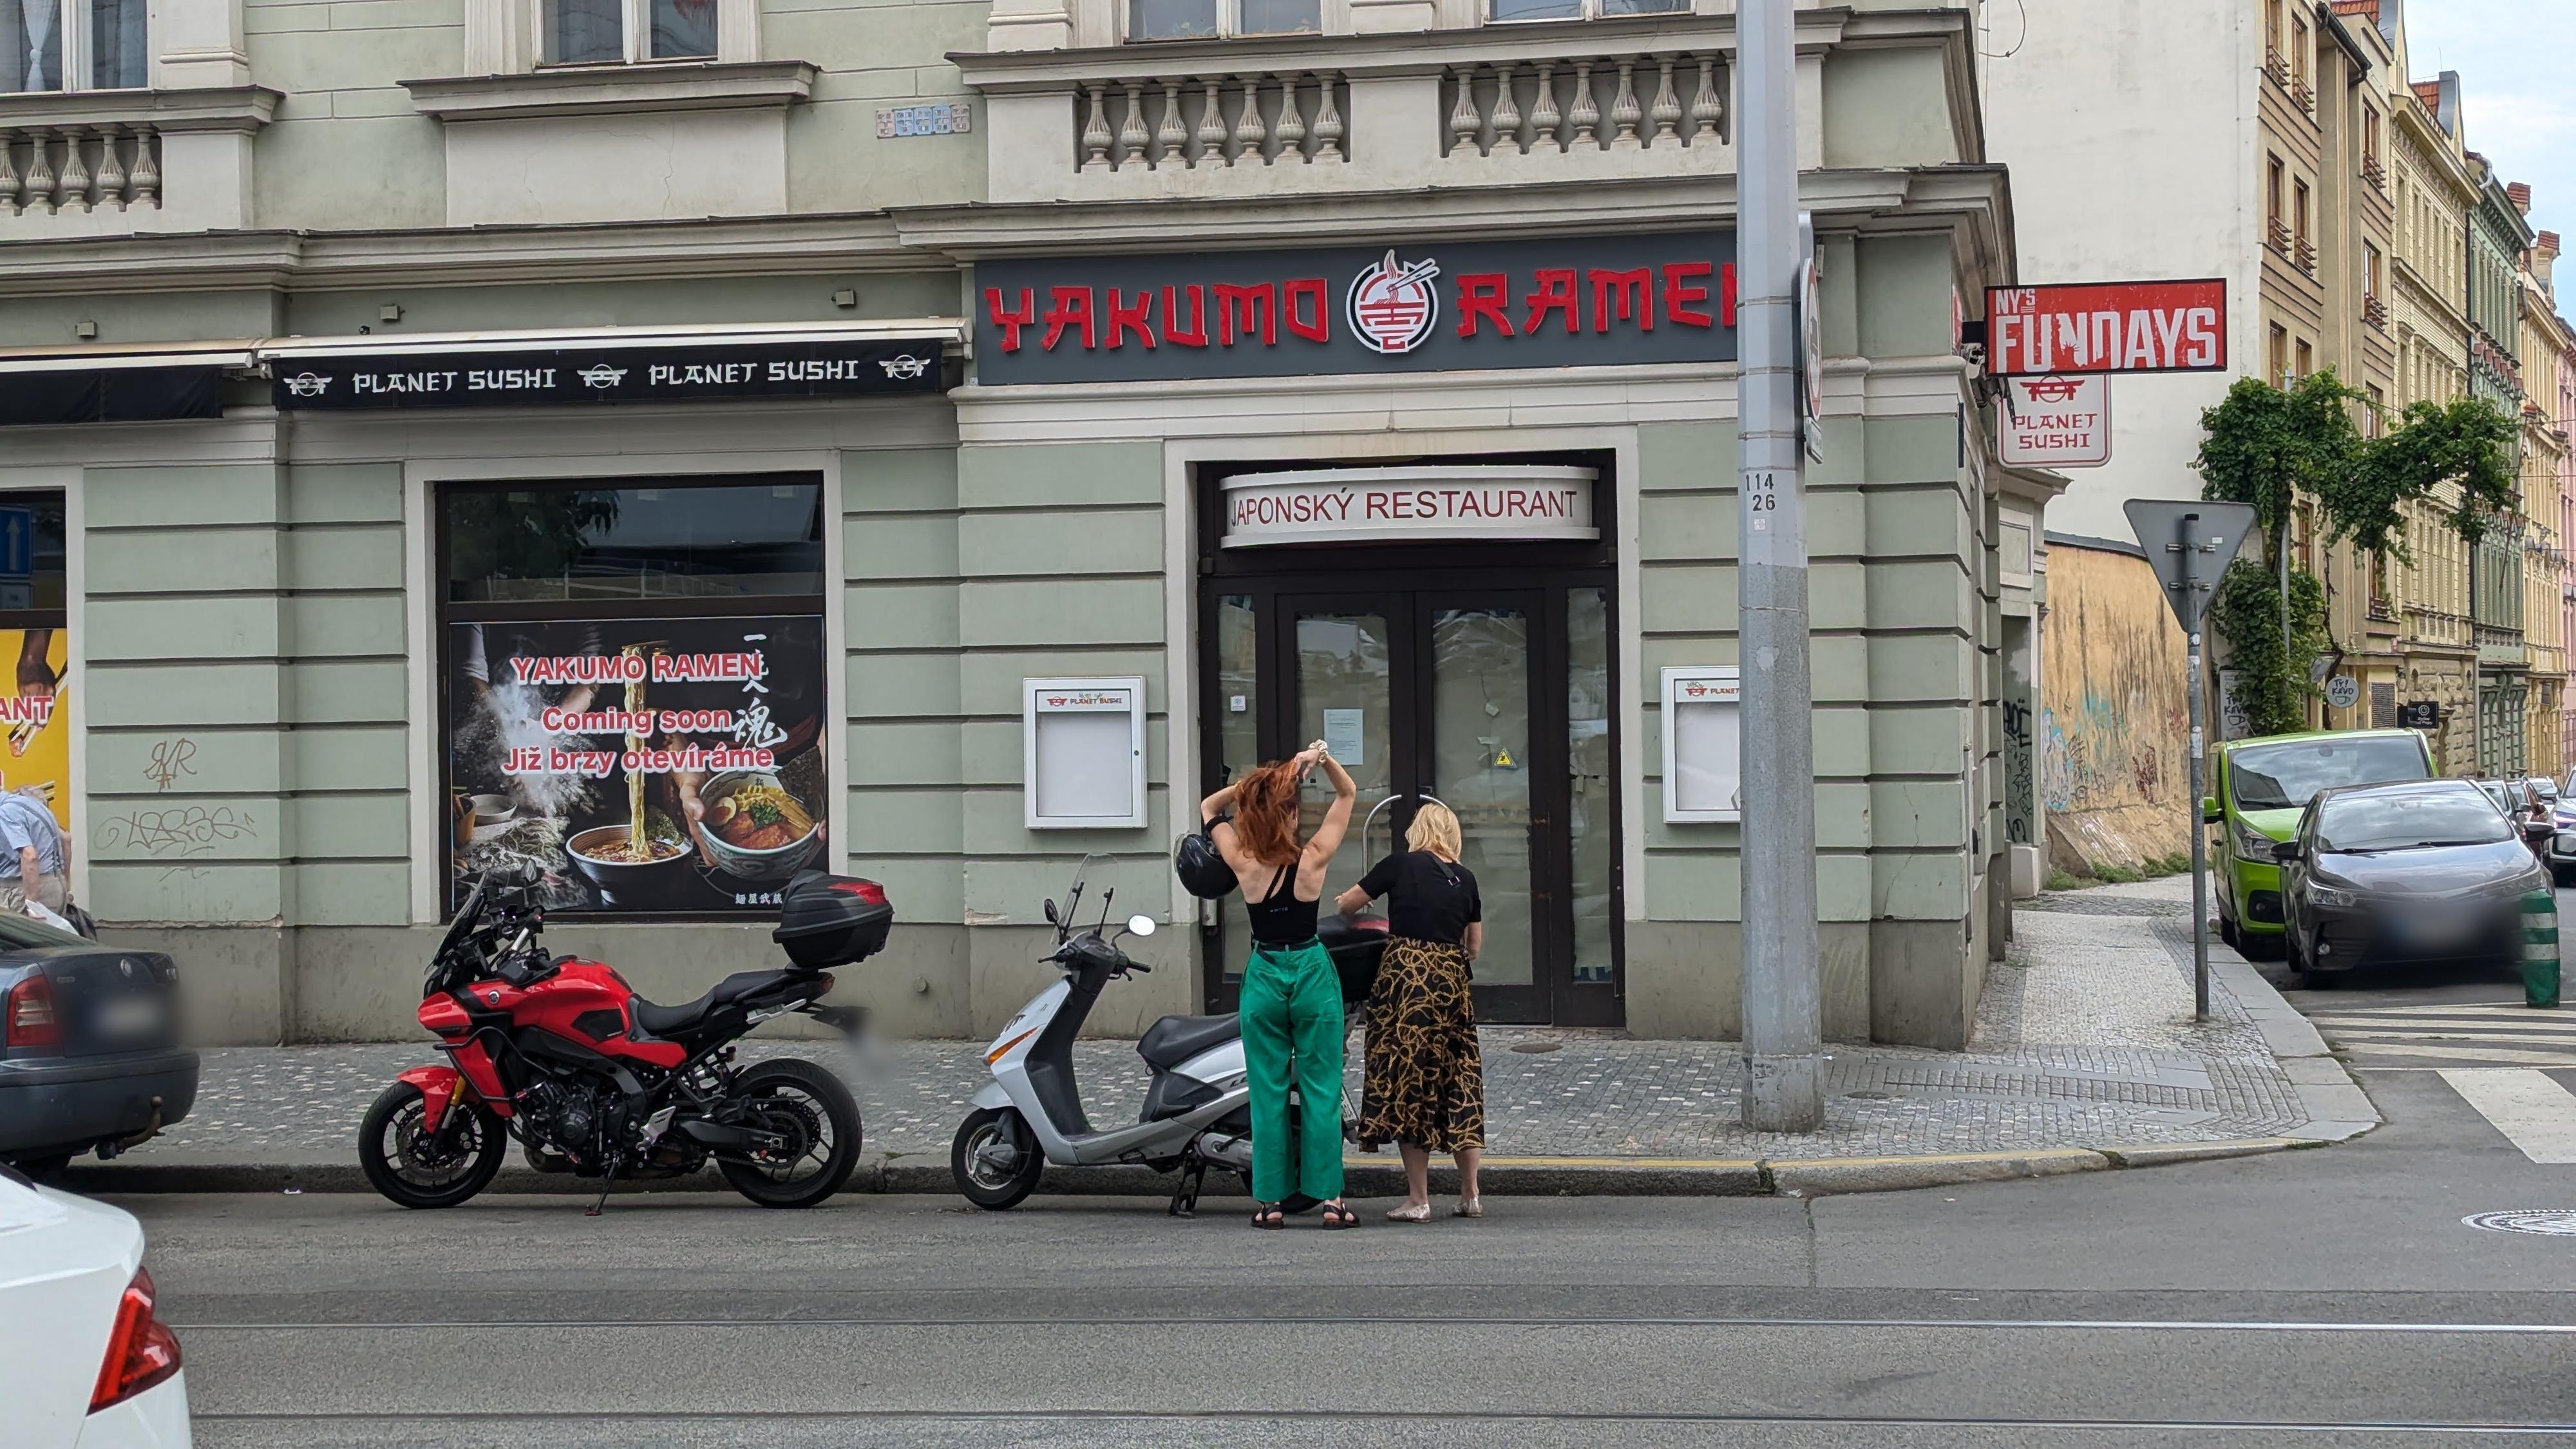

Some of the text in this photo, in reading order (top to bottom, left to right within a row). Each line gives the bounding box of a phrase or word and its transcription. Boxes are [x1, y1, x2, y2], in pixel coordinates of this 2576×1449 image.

[1996, 288, 2036, 314] NY'S
[984, 278, 1330, 353] YAKUMO
[1996, 307, 2217, 374] FUNDAYS
[352, 368, 557, 394] PLANET SUSHI
[649, 359, 859, 386] PLANET SUSHI
[2012, 413, 2098, 431] PLANET
[2018, 433, 2091, 450] SUSHI
[1746, 473, 1774, 492] 114
[1231, 487, 1578, 527] JAPONSKÝ RESTAURANT
[1752, 494, 1776, 511] 26
[512, 653, 761, 683] YAKUMO RAMEN
[542, 707, 731, 735] Coming soon
[503, 743, 773, 775] Již brzy otevíráme
